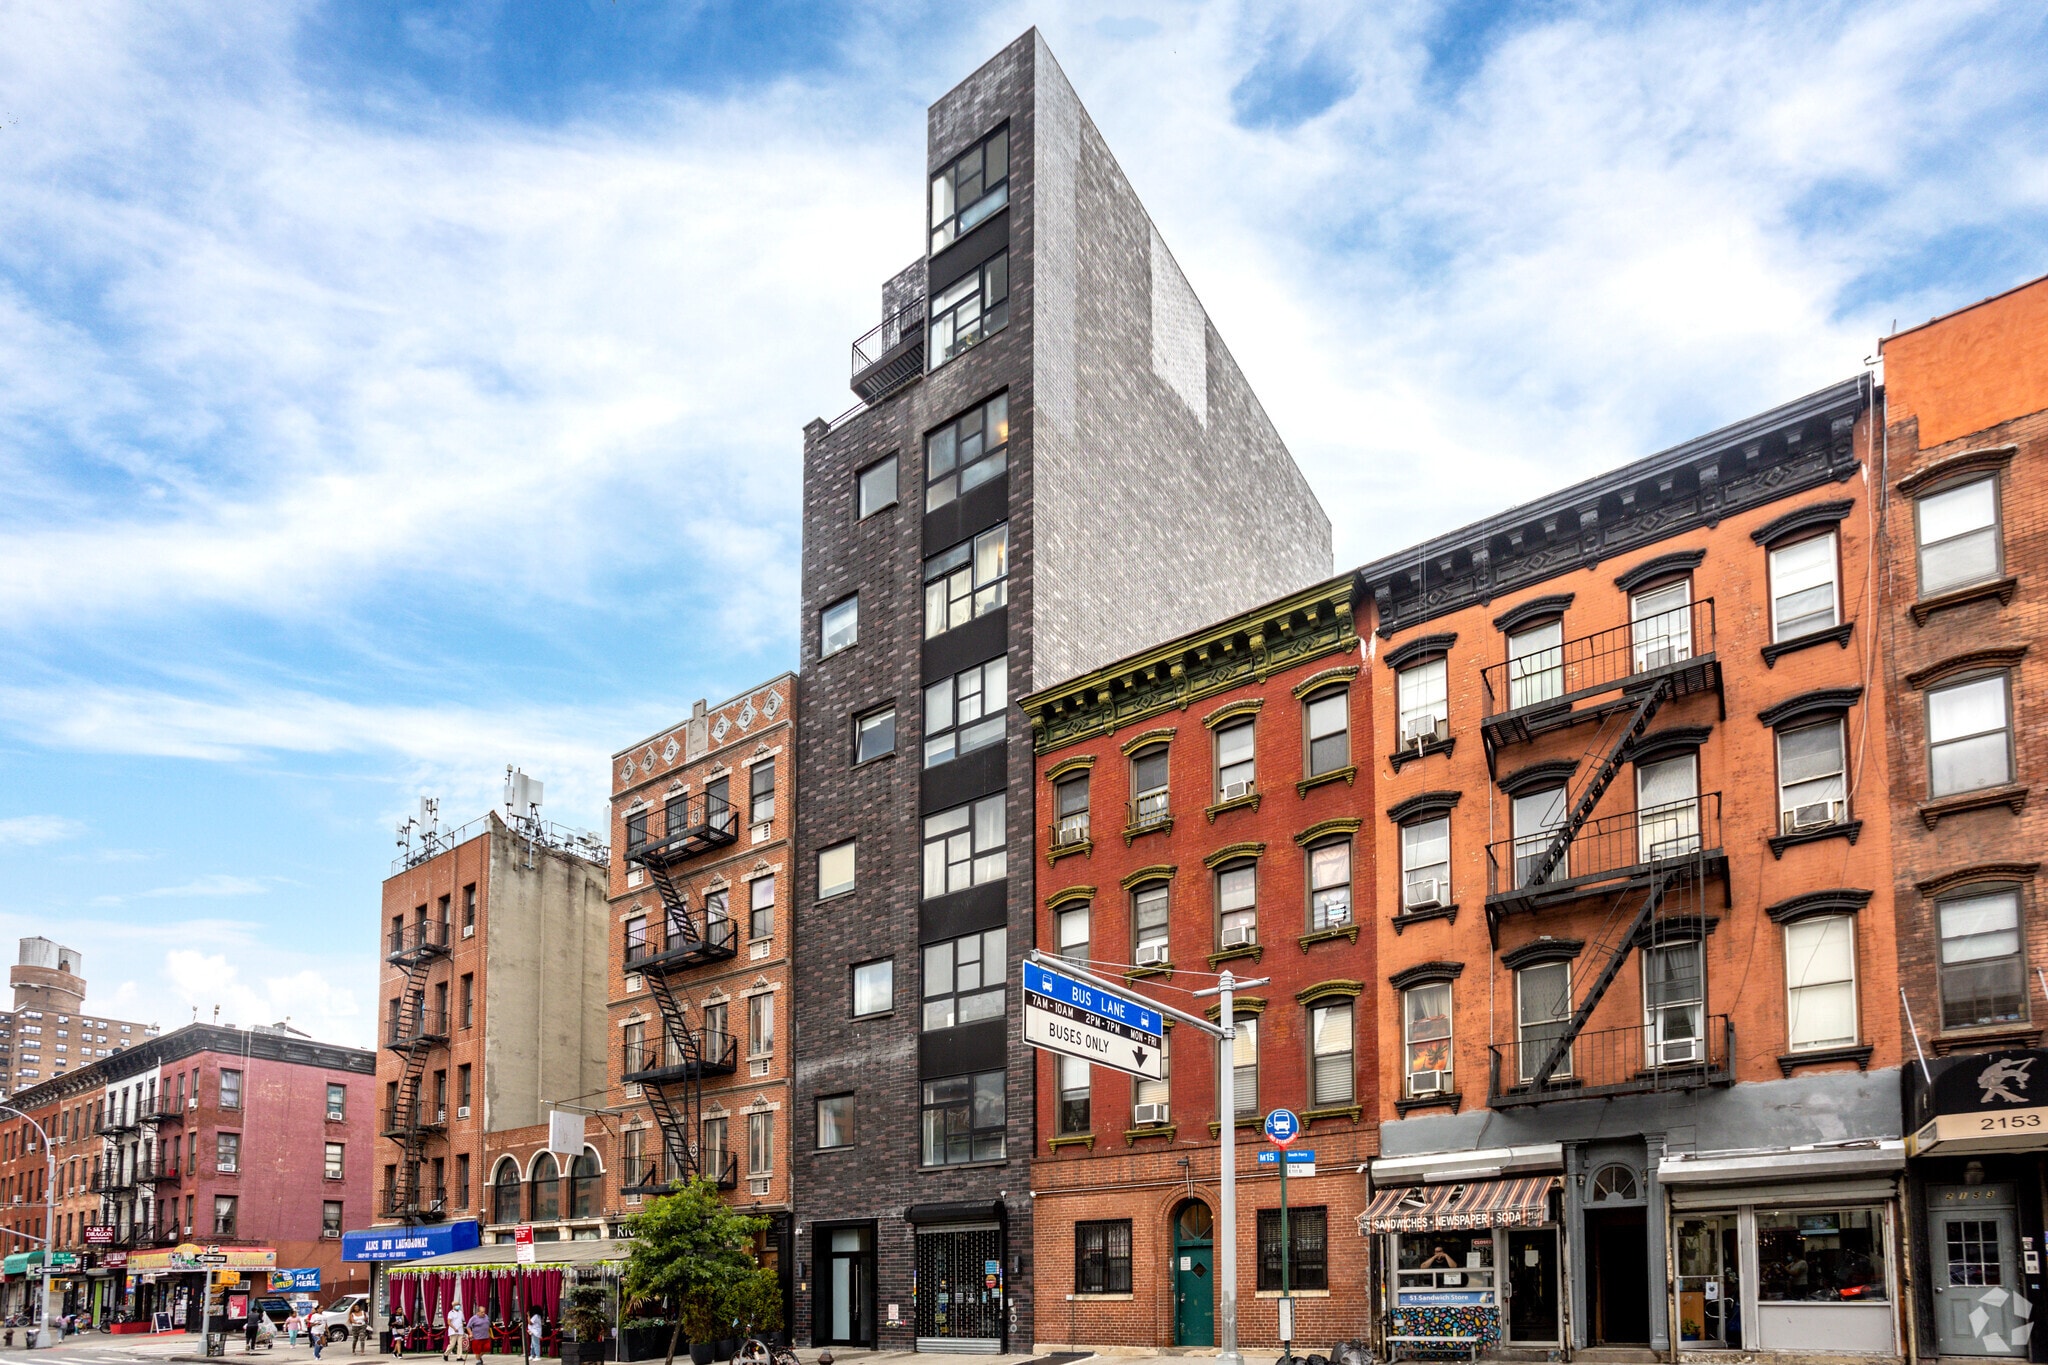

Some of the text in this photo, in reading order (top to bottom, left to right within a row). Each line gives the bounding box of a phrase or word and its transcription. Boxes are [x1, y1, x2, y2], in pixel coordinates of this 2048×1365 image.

[1072, 985, 1126, 1019] BUS LANE
[1032, 994, 1049, 1010] 7AM
[1055, 1002, 1074, 1018] 10AM
[1085, 1013, 1101, 1028] 2PM
[1106, 1020, 1121, 1034] 7PM
[1049, 1022, 1110, 1053] BUSES ONLY
[1980, 1114, 2041, 1130] 2153
[1259, 1153, 1275, 1162] M15
[1945, 1190, 1996, 1200] 2153
[1374, 1217, 1428, 1230] SANDWICHES
[1435, 1213, 1488, 1227] NEWSPAPER
[1495, 1211, 1521, 1223] SODA
[1418, 1293, 1450, 1301] Sandwich
